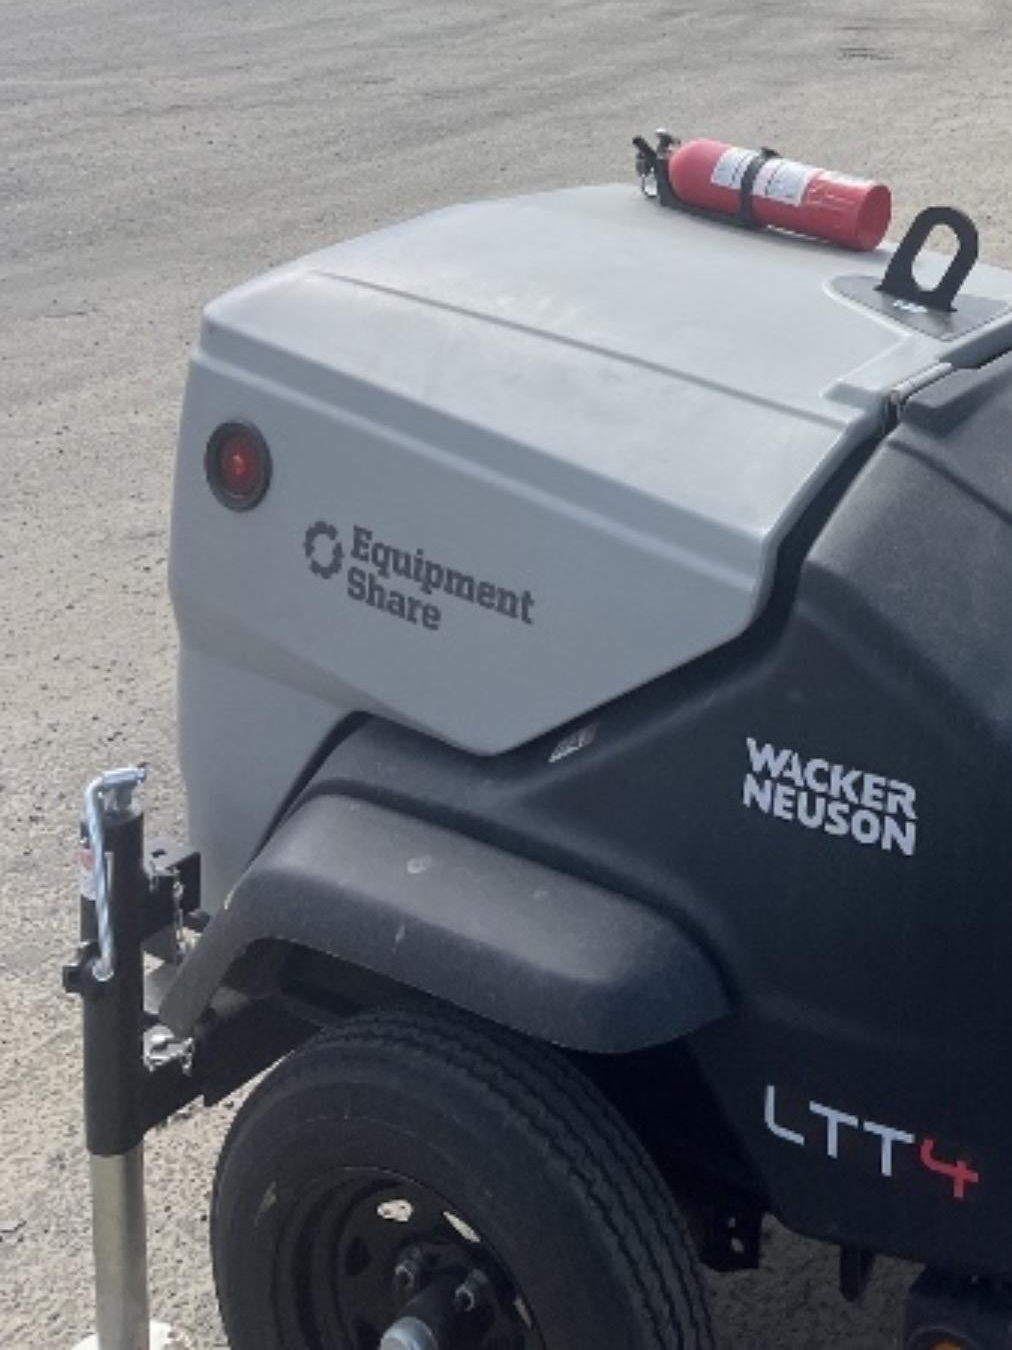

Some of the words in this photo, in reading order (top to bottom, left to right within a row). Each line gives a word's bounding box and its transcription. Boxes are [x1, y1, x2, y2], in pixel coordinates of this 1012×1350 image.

[347, 566, 441, 630] Share
[350, 524, 535, 625] Equipment
[743, 772, 917, 857] NEUSON
[746, 736, 918, 820] WACKER
[764, 1085, 979, 1199] LTT4
